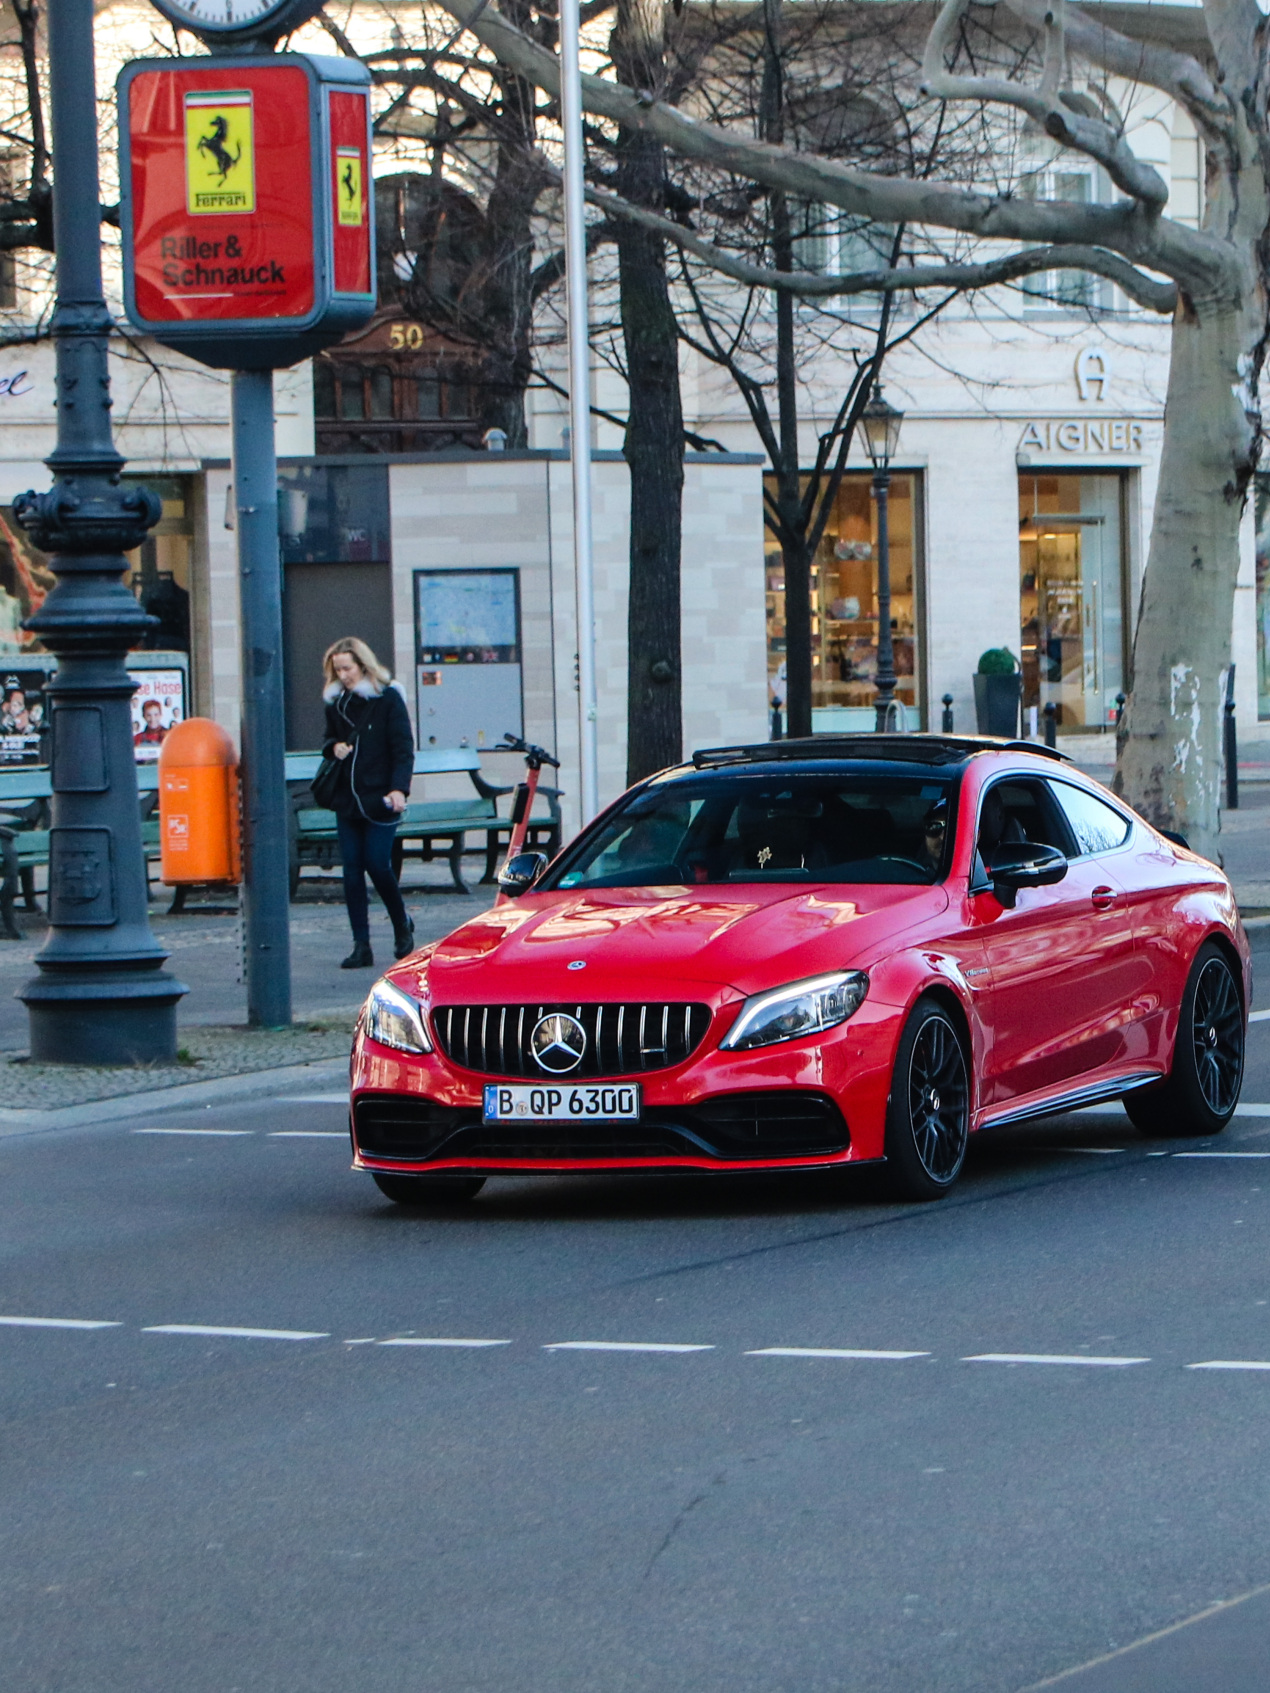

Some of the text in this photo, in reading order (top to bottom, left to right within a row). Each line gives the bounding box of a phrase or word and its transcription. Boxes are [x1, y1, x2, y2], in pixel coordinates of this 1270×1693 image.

[195, 193, 246, 208] Ferrari
[160, 235, 242, 260] Riller &
[163, 260, 286, 287] Schnauck
[391, 324, 423, 350] 50
[1016, 422, 1142, 452] AIGNER
[500, 1089, 633, 1114] B QP 6300
